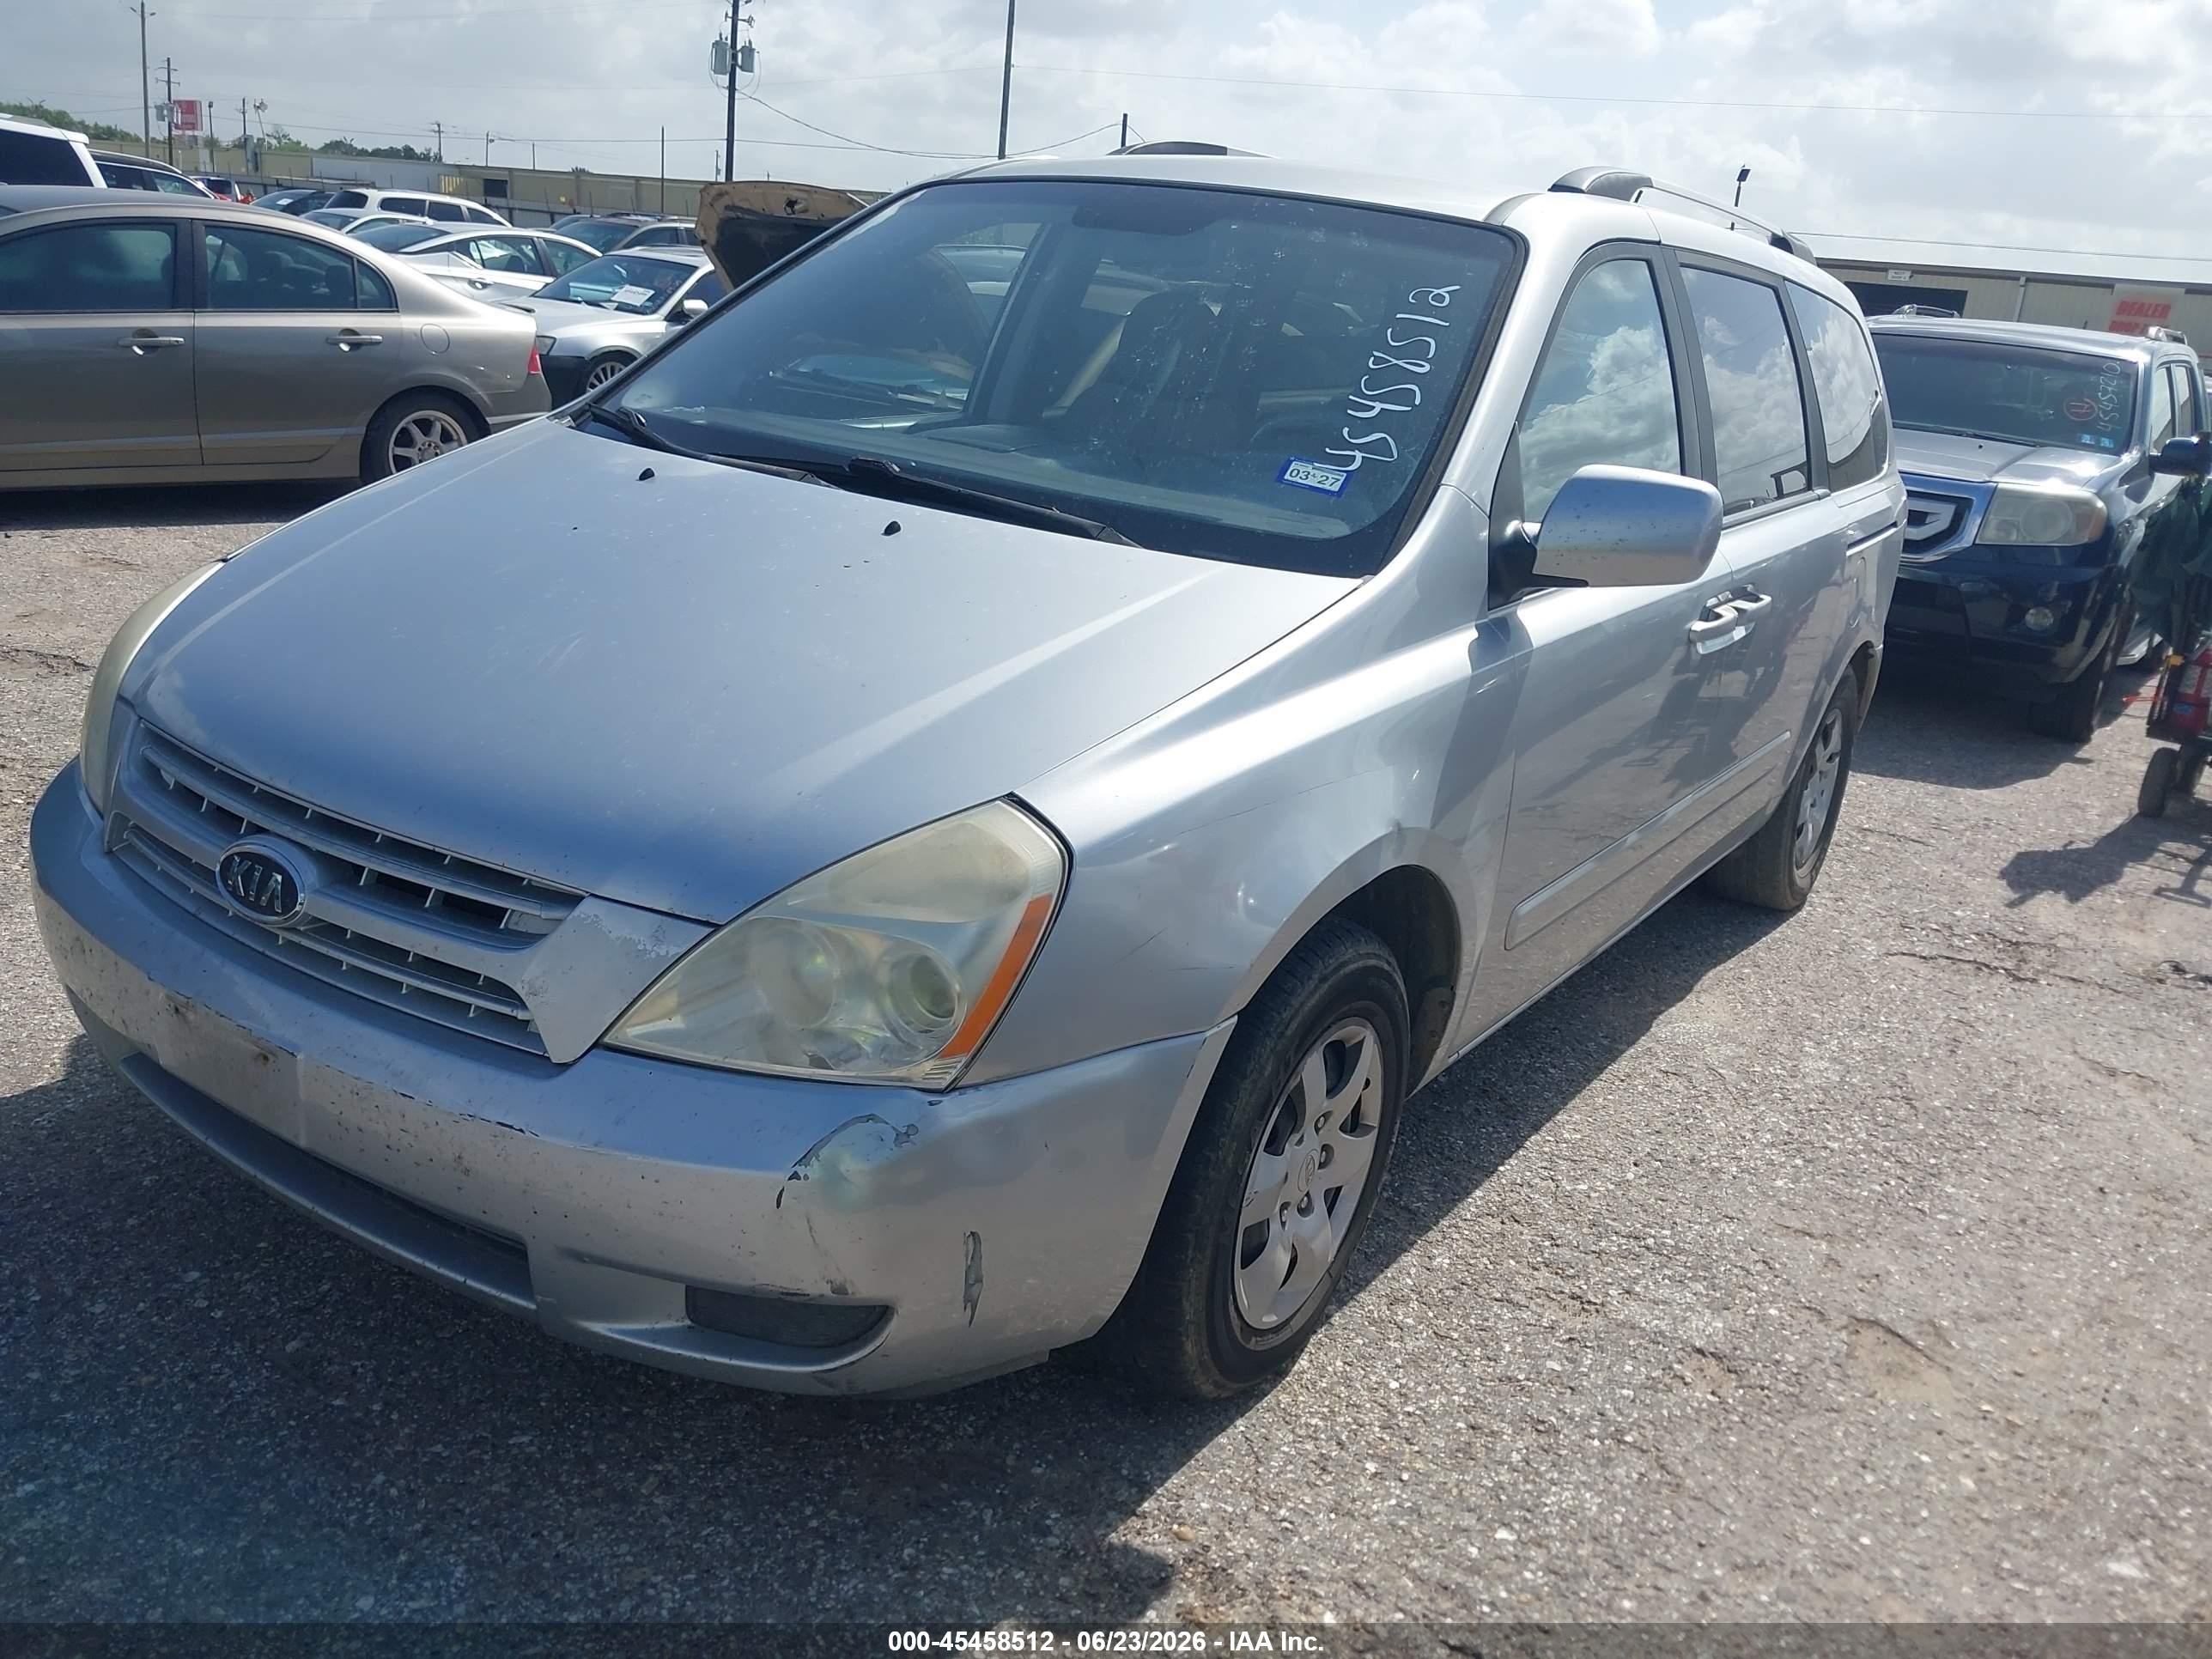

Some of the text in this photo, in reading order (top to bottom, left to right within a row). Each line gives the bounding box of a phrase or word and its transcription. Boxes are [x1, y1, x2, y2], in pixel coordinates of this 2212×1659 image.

[2116, 301, 2171, 319] DEALER
[1313, 285, 1462, 471] 45458512
[1289, 468, 1311, 481] 03
[1317, 475, 1341, 487] 27
[228, 854, 282, 913] KIA
